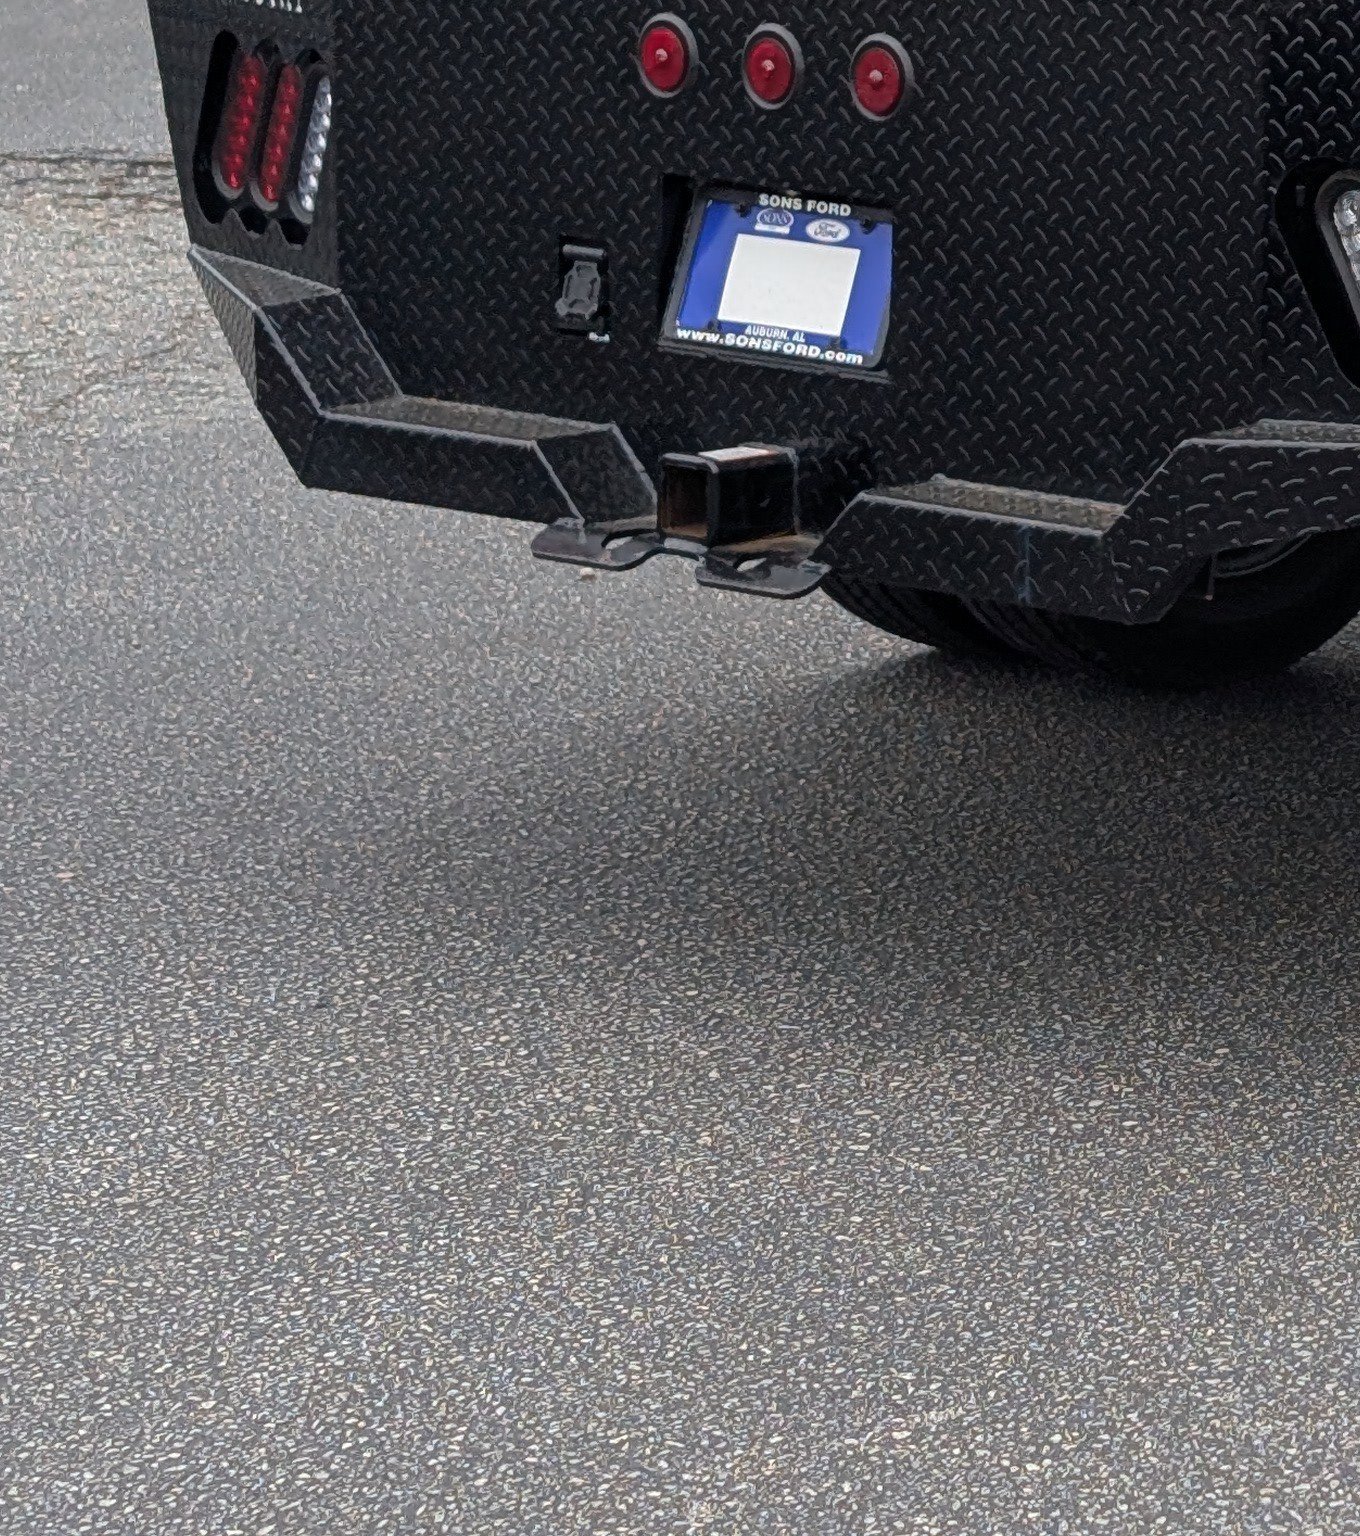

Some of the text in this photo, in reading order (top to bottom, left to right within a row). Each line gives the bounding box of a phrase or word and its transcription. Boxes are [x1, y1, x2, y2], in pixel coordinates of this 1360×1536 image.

[758, 193, 852, 217] SONS FORD
[676, 327, 865, 365] www.SONSFORD.com
[792, 330, 806, 343] AL
